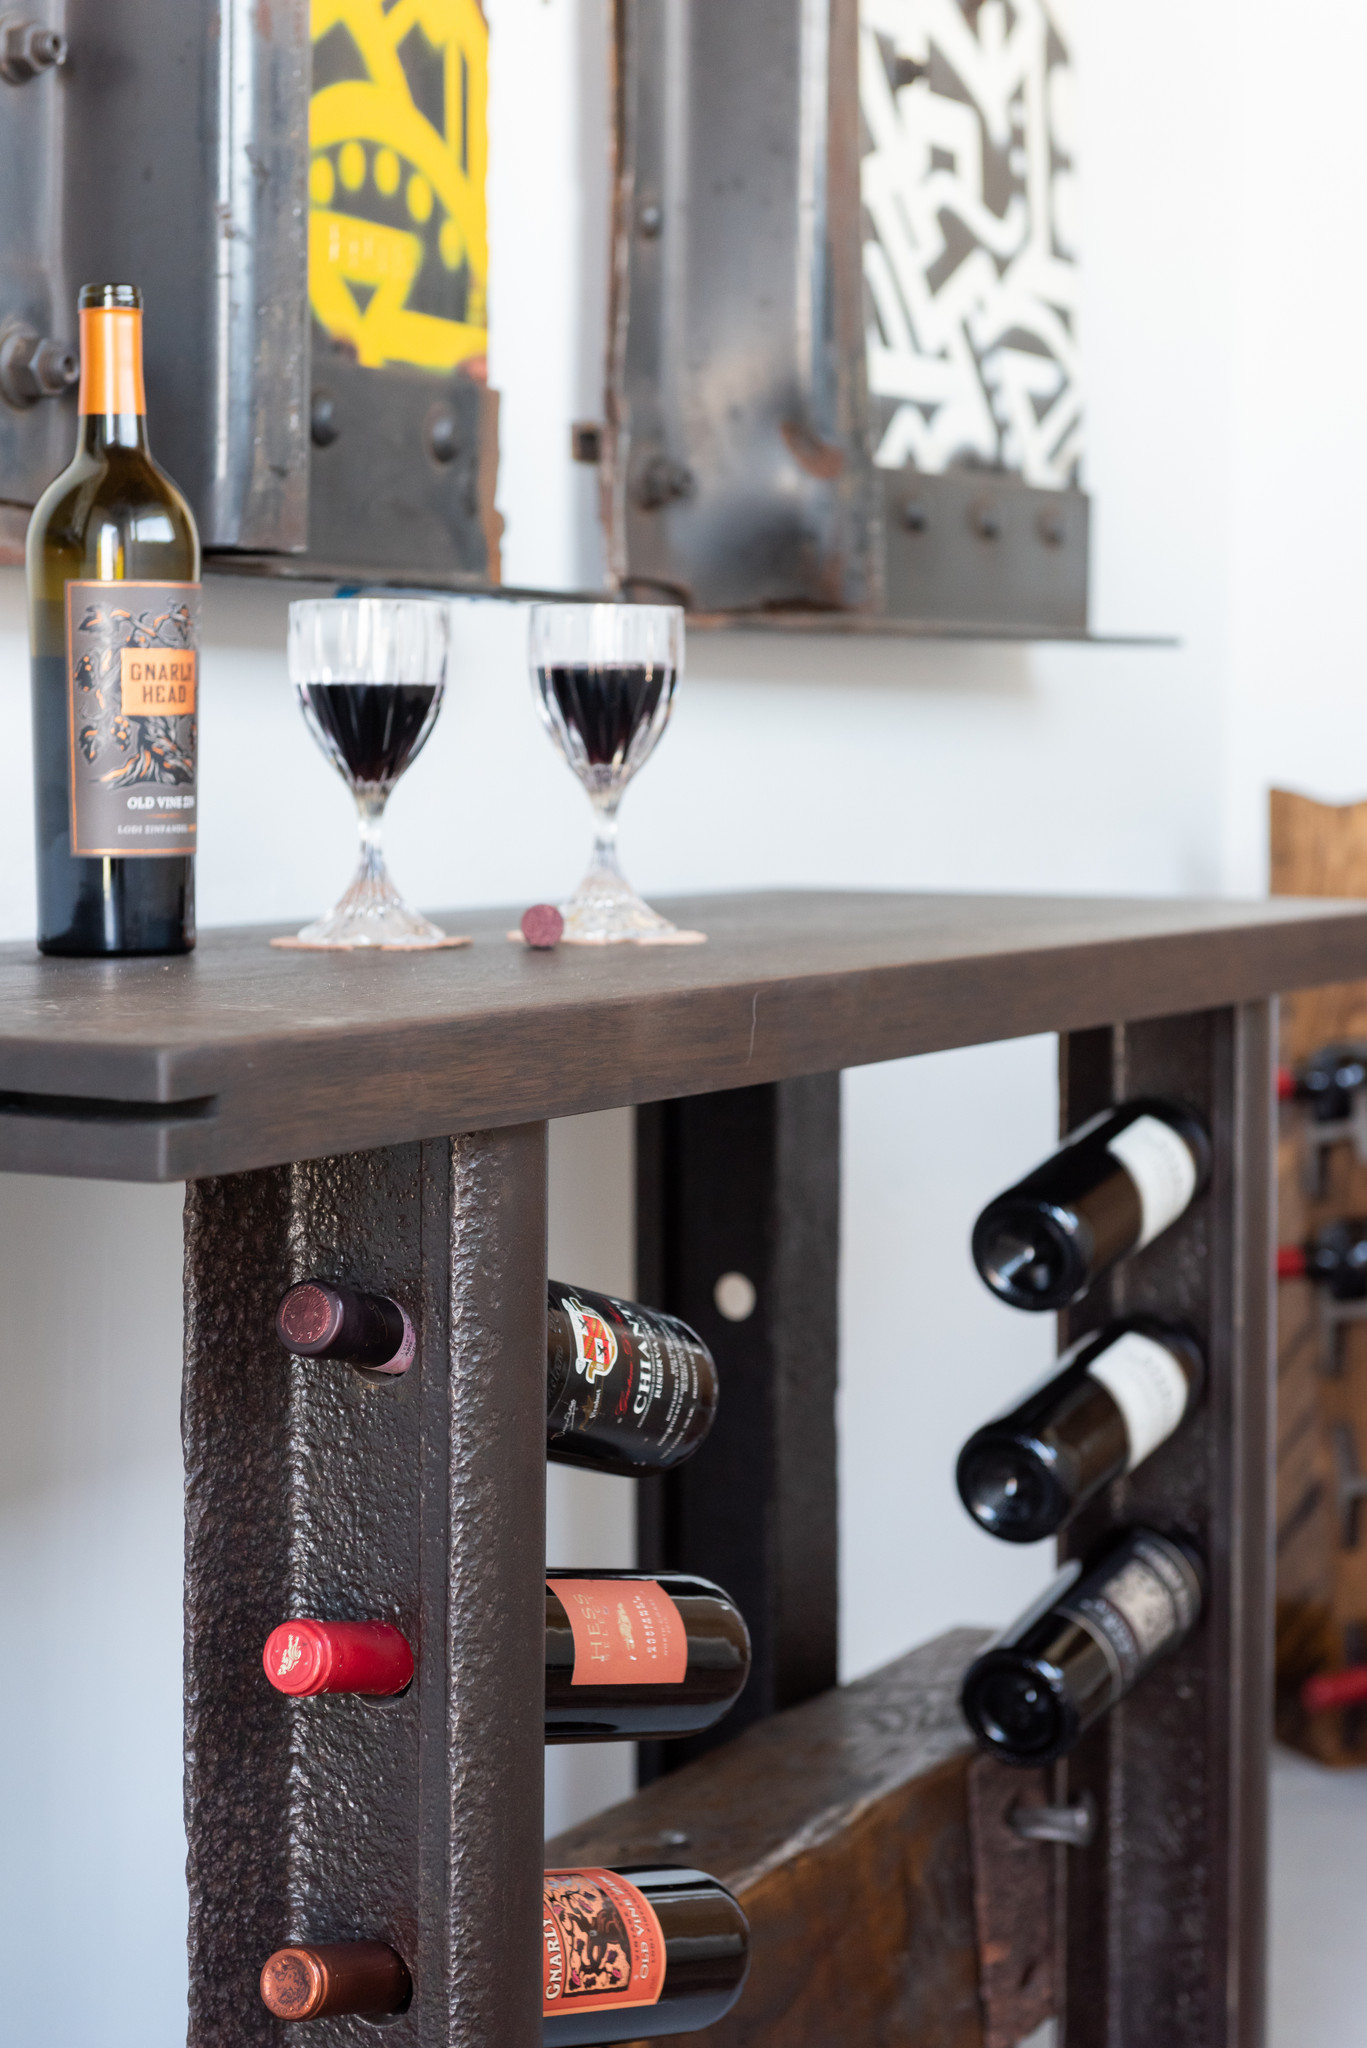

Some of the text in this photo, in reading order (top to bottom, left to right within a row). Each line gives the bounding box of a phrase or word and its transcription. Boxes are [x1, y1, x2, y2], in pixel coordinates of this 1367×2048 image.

[142, 685, 187, 704] HEAD
[126, 796, 155, 810] OLD
[157, 796, 182, 810] VINE
[610, 1300, 652, 1414] CHIANTI
[652, 1341, 664, 1399] RISERVA
[572, 1594, 602, 1660] HESS
[624, 1898, 645, 1936] VINE
[543, 1918, 563, 2000] GNARLY
[640, 1941, 649, 1979] OLD
